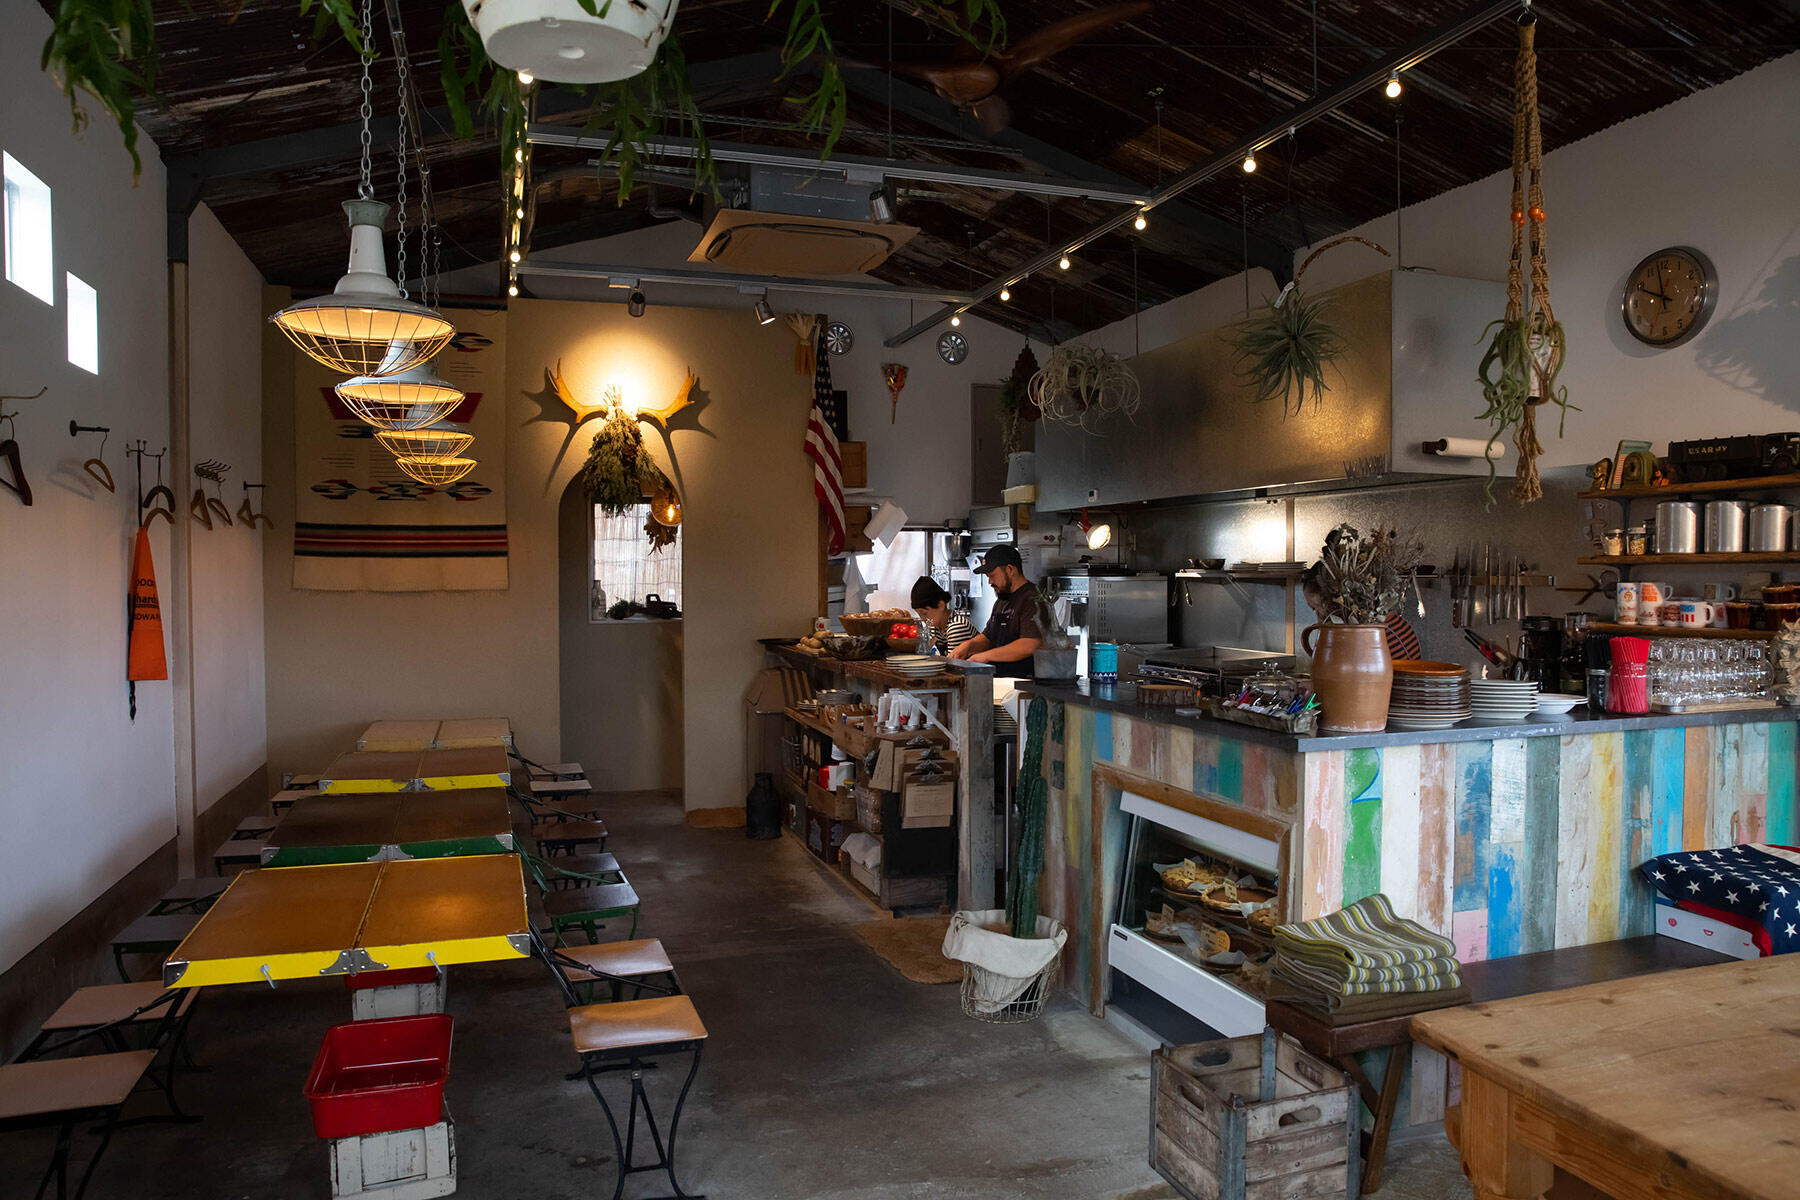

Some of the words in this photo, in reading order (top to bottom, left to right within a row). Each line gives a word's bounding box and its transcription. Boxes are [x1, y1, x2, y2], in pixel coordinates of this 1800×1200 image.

[1660, 260, 1669, 270] 12
[1647, 268, 1654, 278] 11
[1689, 270, 1694, 280] 2
